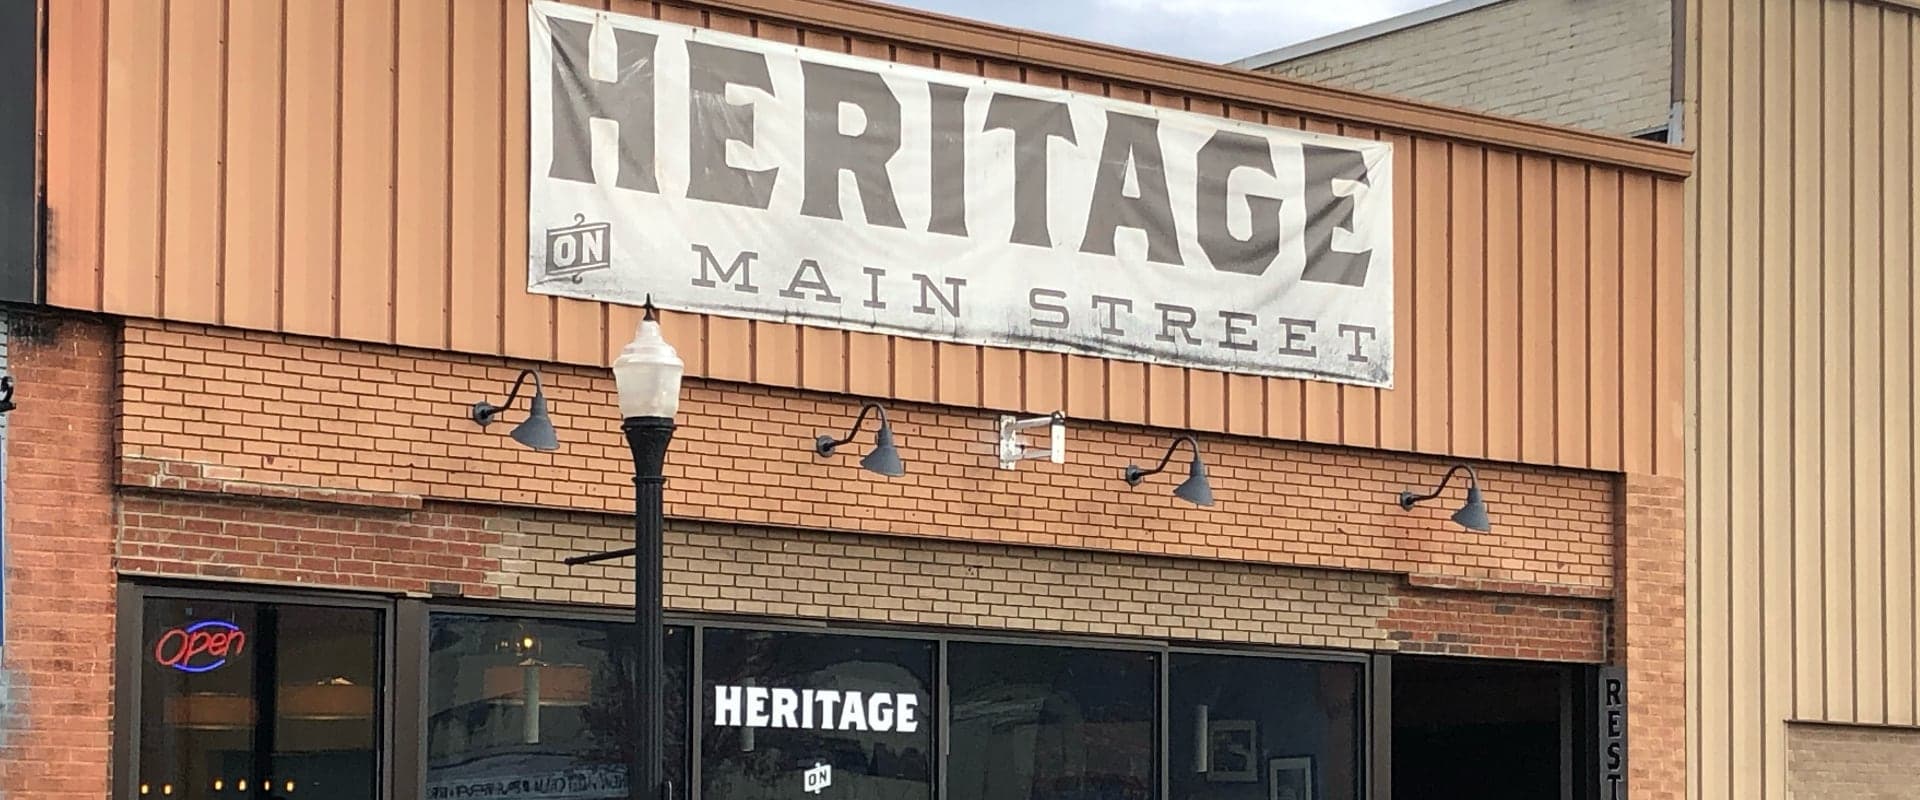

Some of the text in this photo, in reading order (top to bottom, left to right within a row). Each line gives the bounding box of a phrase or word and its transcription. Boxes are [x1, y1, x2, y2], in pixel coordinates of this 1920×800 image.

[547, 15, 1376, 288] HERITAGE
[553, 230, 605, 268] ON
[691, 244, 1376, 363] MAIN STREET
[155, 628, 245, 666] Open
[714, 685, 919, 733] HERITAGE
[808, 769, 828, 787] ON
